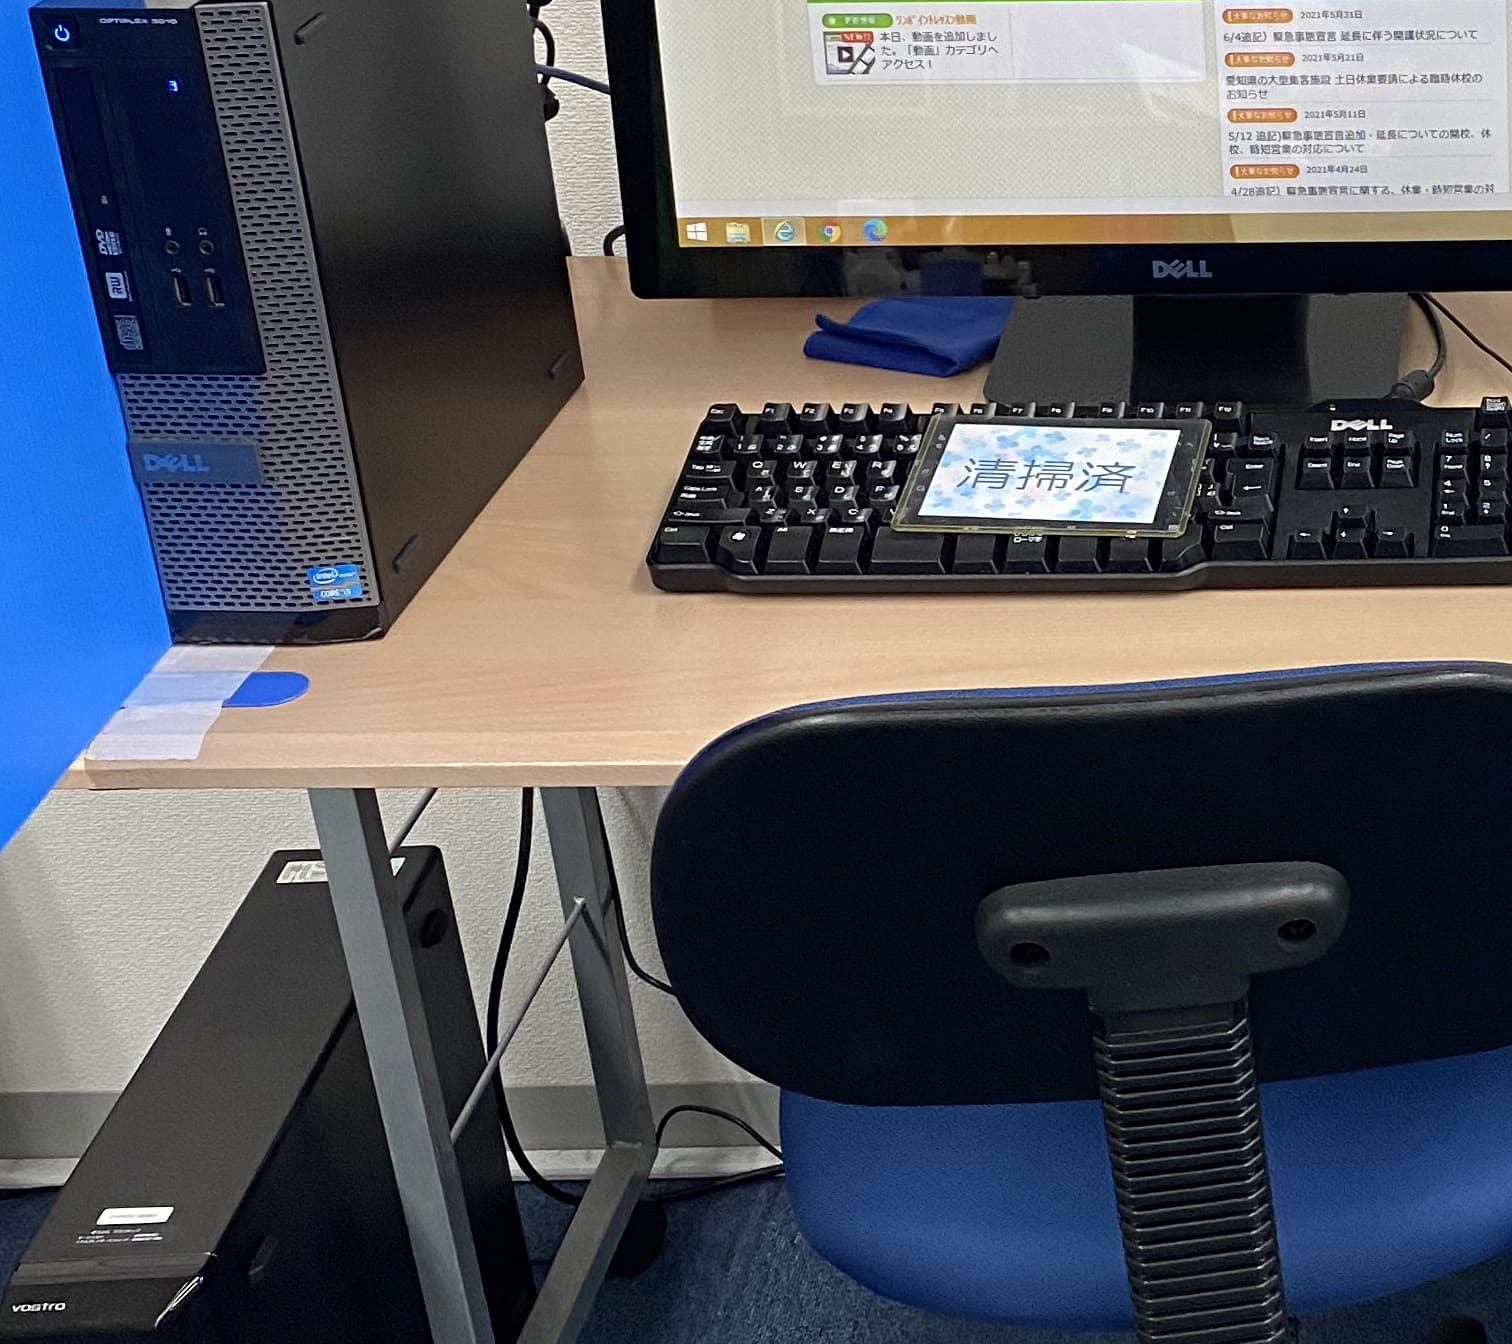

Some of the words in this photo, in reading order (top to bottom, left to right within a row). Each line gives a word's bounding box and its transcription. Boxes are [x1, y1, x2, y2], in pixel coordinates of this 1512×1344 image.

[1301, 10, 1363, 20] 2021年5月31日
[880, 31, 998, 43] 本日、動画を追加しまし
[1302, 53, 1364, 63] 2021年5月21日
[1226, 89, 1269, 101] お知らせ
[1304, 110, 1366, 120] 2021年5月11日
[1152, 259, 1213, 279] DELL
[1330, 418, 1394, 432] DELL
[144, 454, 210, 472] DELL
[956, 458, 1137, 494] 清掃済
[12, 1302, 66, 1313] vostro
